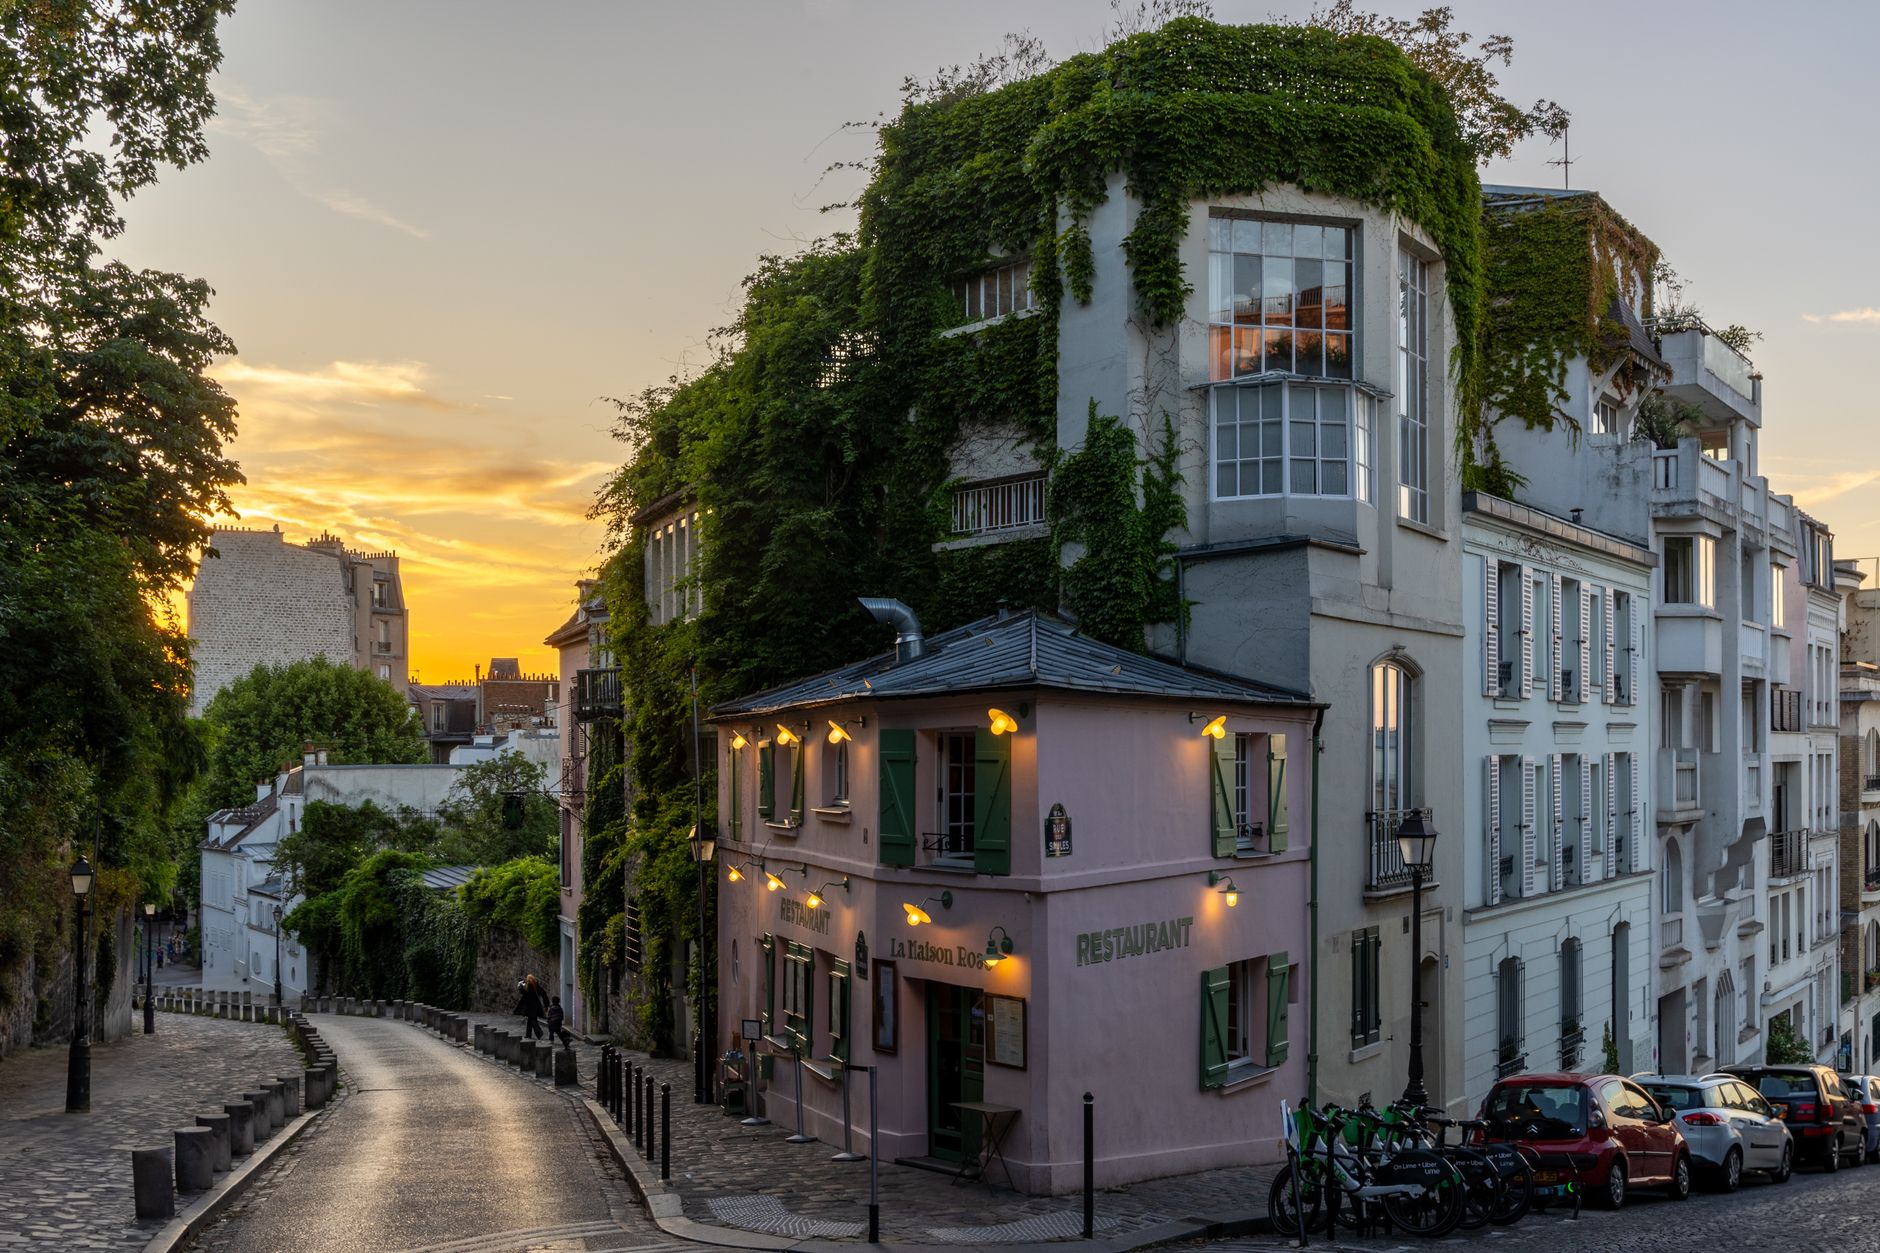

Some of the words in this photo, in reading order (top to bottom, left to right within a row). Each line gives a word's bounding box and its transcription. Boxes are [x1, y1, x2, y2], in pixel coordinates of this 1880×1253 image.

[1053, 824, 1065, 833] RUE
[780, 897, 831, 935] RESTAURANT
[890, 938, 906, 958] La
[907, 939, 954, 966] Maison
[1076, 916, 1194, 967] RESTAURANT
